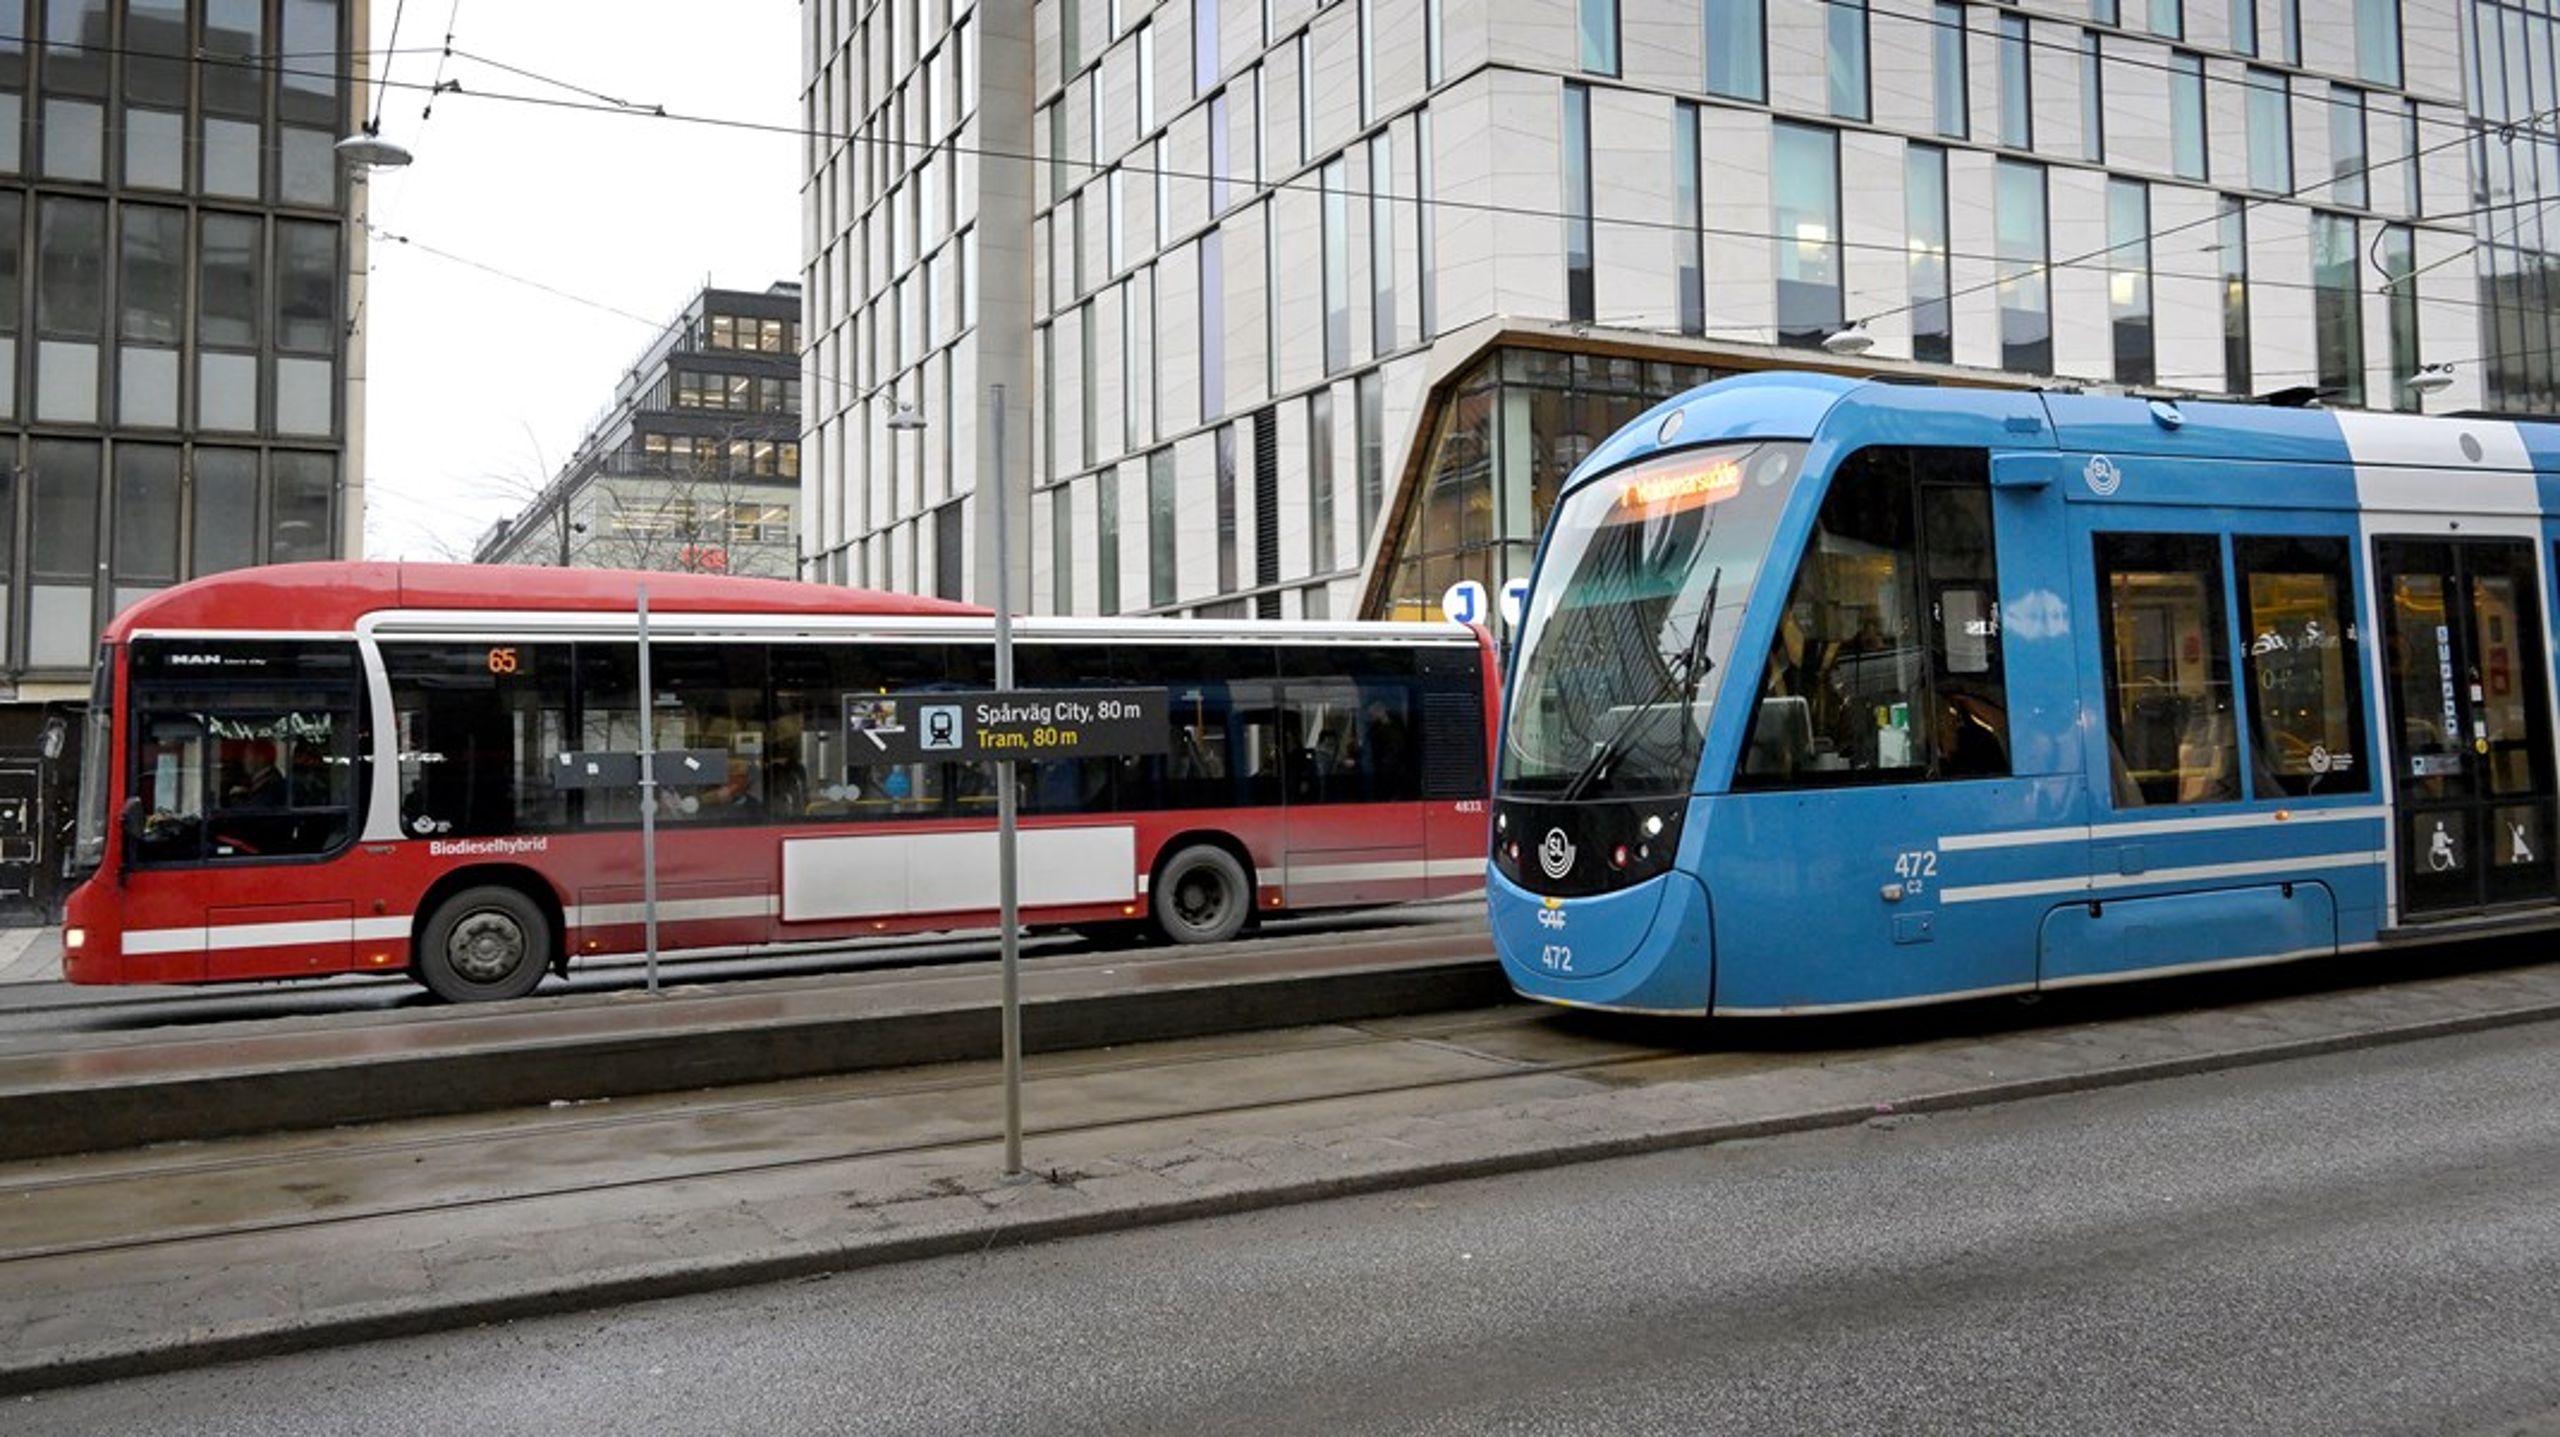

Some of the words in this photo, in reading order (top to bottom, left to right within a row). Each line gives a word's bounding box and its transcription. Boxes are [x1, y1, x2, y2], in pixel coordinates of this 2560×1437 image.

[1454, 587, 1475, 623] J
[171, 654, 221, 665] MAN
[489, 648, 516, 672] 65
[976, 702, 1051, 726] Spårväg
[1055, 702, 1094, 724] City,
[1097, 700, 1121, 719] 80
[1124, 704, 1141, 718] m
[976, 729, 1029, 749] Tram,
[1032, 727, 1057, 746] 80
[1061, 731, 1078, 745] m
[429, 837, 548, 856] Biodieselhybrid
[1894, 850, 1937, 878] 472
[1907, 880, 1923, 894] C2
[1542, 945, 1573, 971] 472
